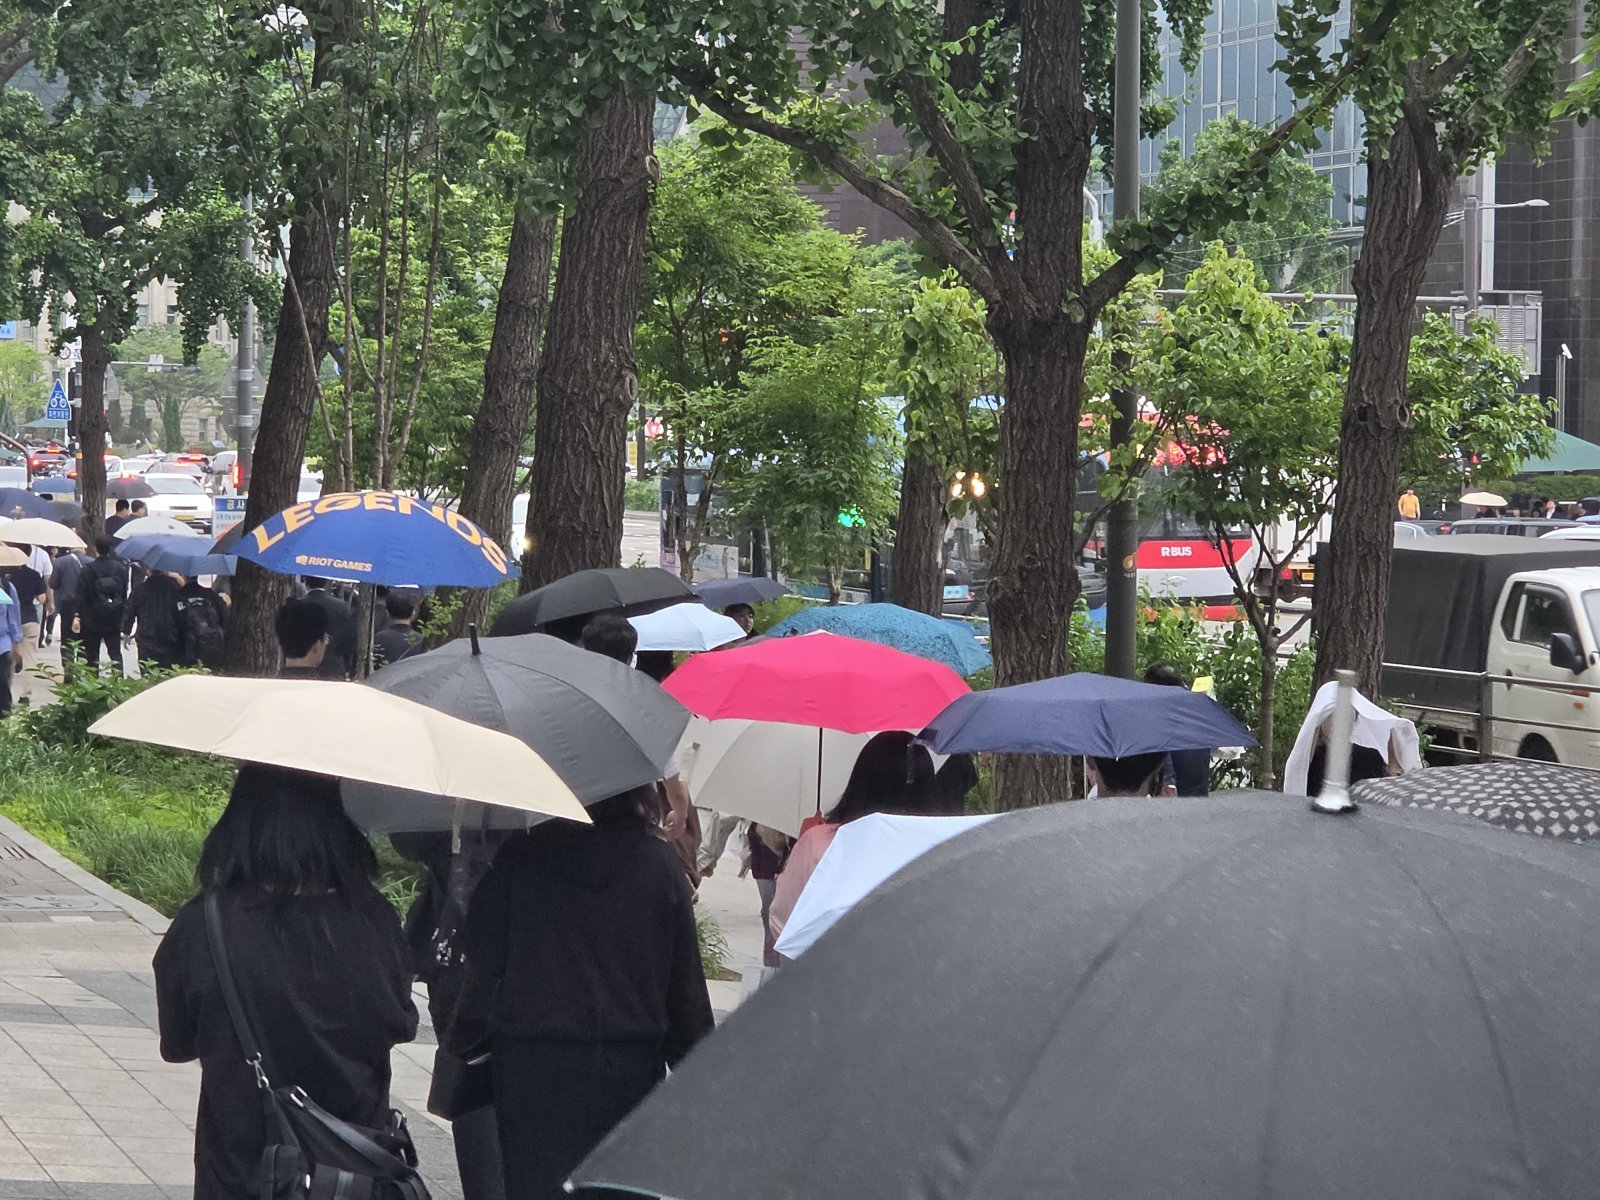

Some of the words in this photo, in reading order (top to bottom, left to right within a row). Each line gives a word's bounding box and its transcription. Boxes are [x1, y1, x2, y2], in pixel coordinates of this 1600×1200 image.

[252, 491, 508, 575] LEGENDS
[308, 556, 334, 567] RIOT
[333, 559, 373, 572] GAMES
